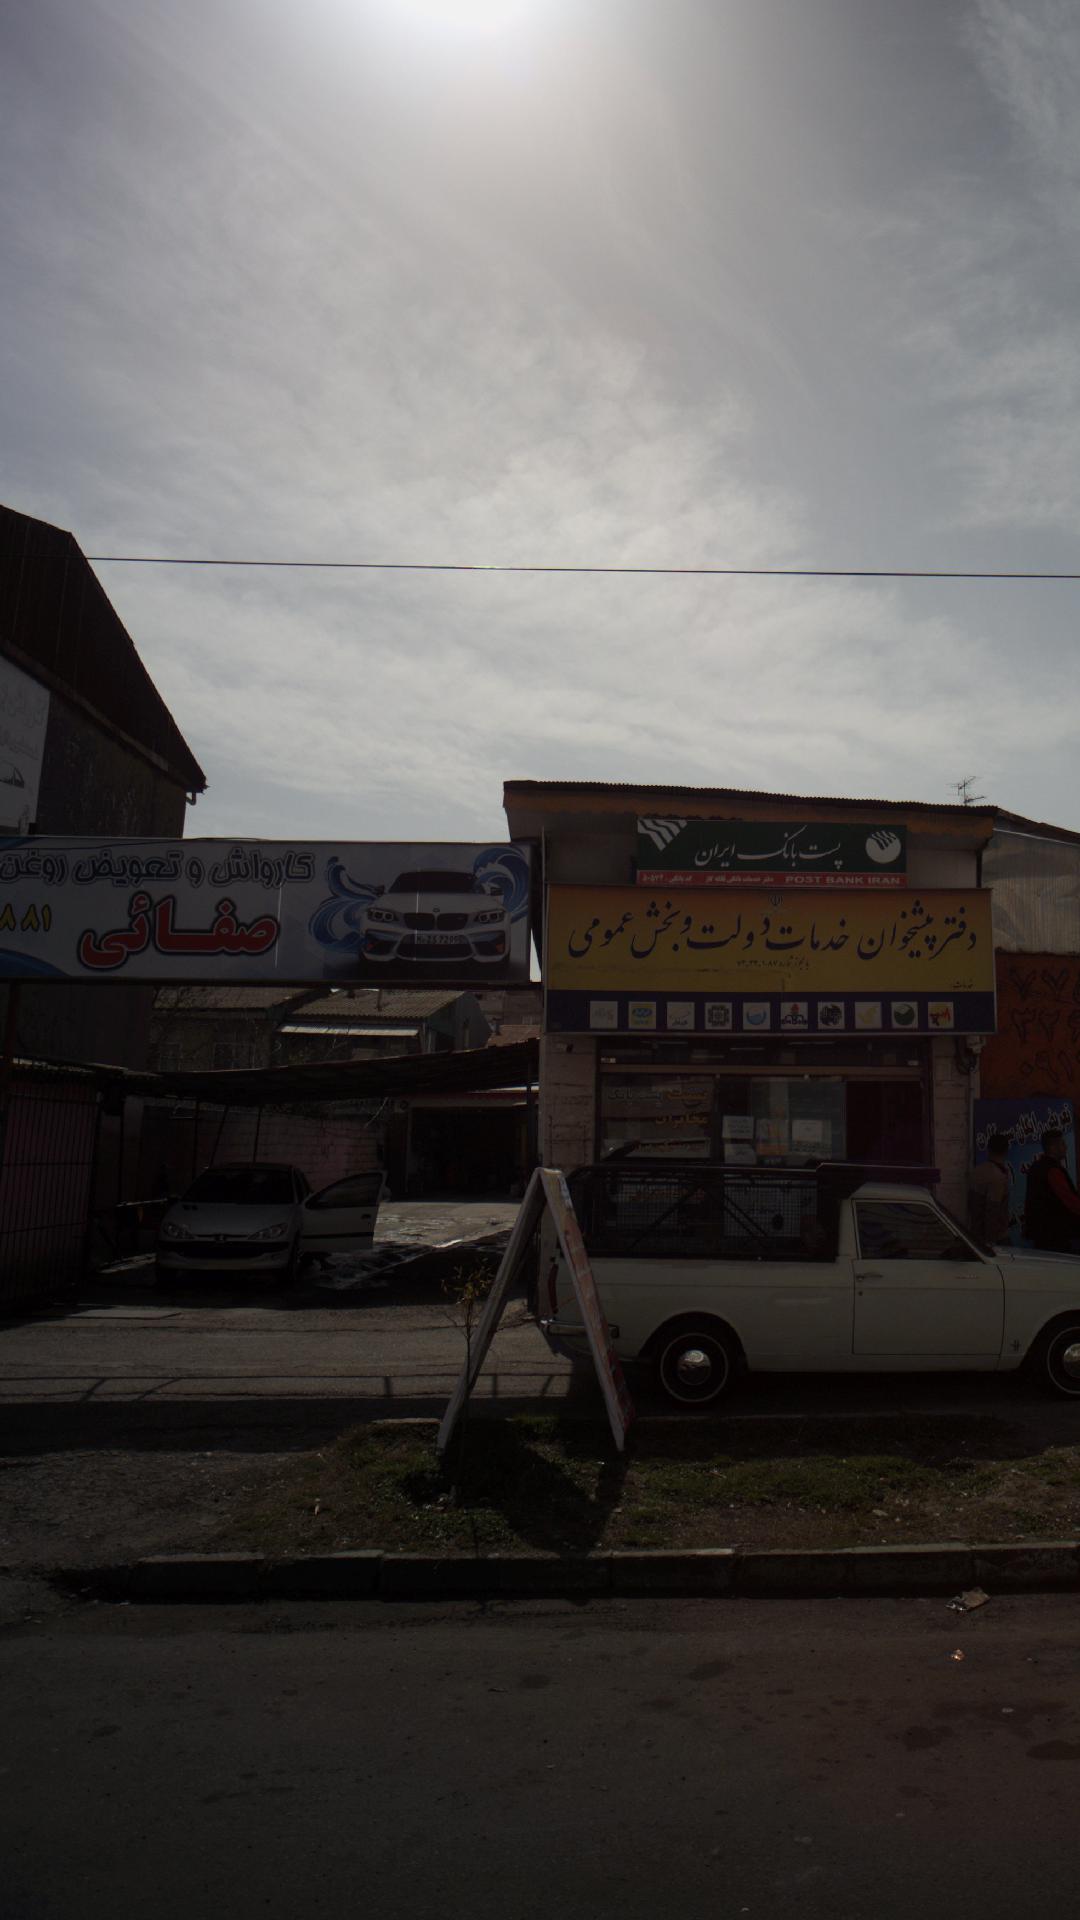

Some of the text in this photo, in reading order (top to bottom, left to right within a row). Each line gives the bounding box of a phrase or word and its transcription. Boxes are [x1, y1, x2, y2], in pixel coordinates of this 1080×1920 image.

[0, 849, 315, 888] کارواش و تعویض روغن
[694, 824, 844, 874] پست بانک ایران
[784, 874, 901, 887] POST BANK IRAN
[77, 890, 281, 970] صفائی
[568, 911, 634, 958] عمومی
[630, 900, 681, 959] بخش
[687, 914, 771, 951] دولت
[765, 917, 850, 950] خدمات
[856, 898, 936, 960] پیشخوان
[928, 905, 977, 960] دفتر
